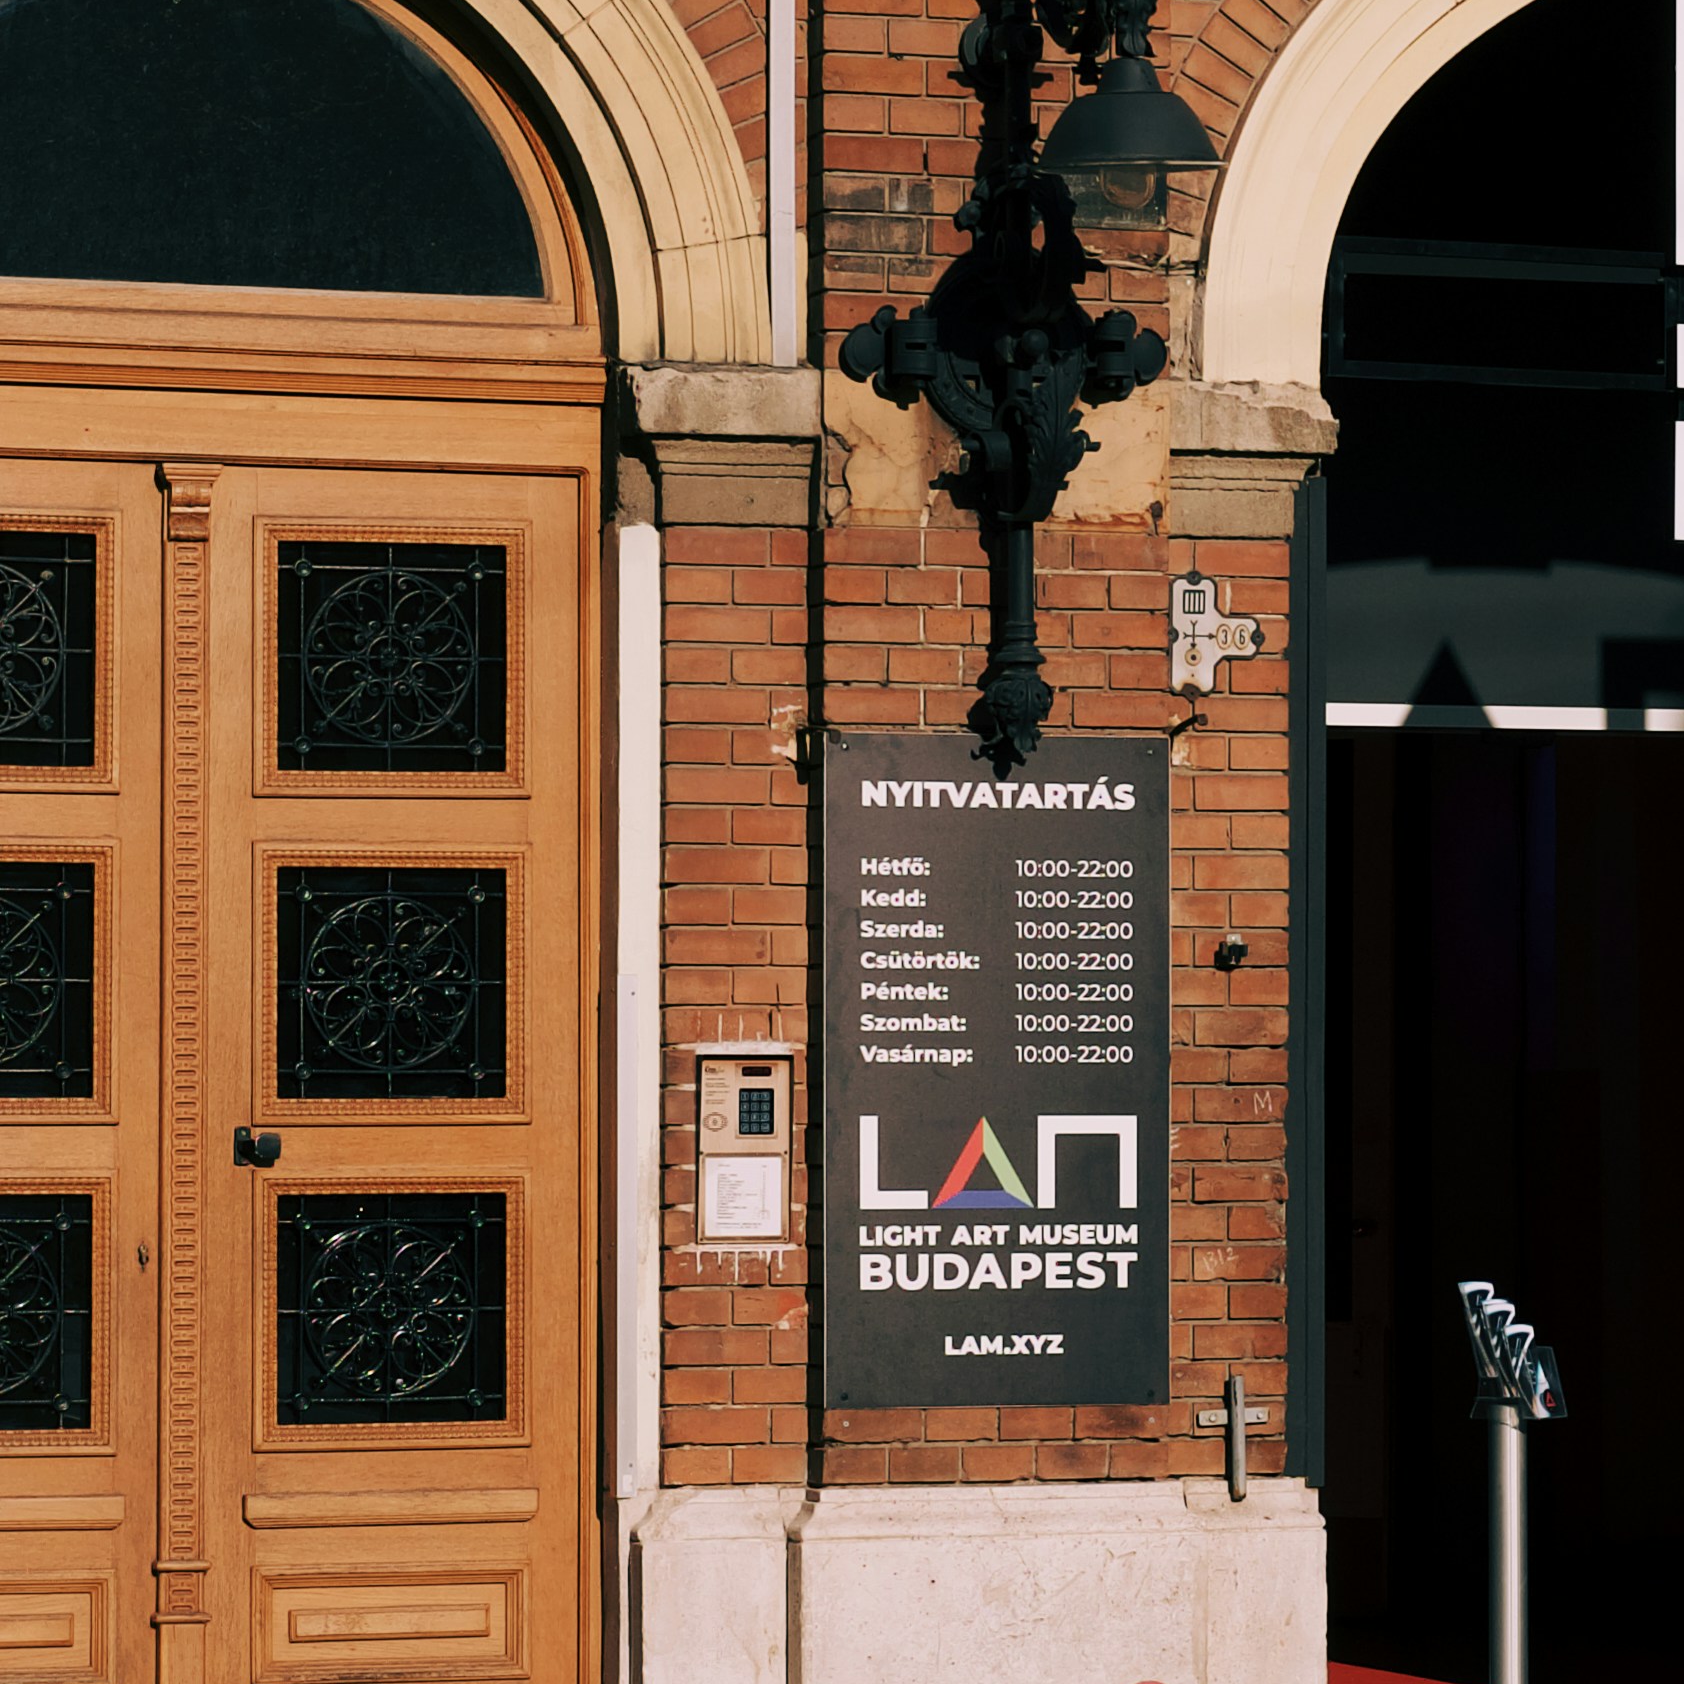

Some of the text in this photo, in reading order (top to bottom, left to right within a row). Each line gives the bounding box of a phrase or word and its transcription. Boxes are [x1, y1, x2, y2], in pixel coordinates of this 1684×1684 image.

[862, 777, 1135, 810] NYITVATARTÁS
[861, 857, 1133, 877] Hétfő: 10:00-22:00
[861, 889, 1133, 908] Kedd: 10:00-22:00
[861, 920, 1133, 939] Szerda: 10:00-22:00
[861, 951, 1133, 970] Csütörtök: 10:00-22:00
[861, 982, 1133, 1001] Péntek: 10:00-22:00
[860, 1013, 1133, 1032] Szombat: 10:00-22:00
[860, 1044, 1133, 1066] Vasárnap: 10:00-22:00
[860, 1224, 1138, 1246] LIGHT ART MUSEUM
[860, 1252, 1138, 1290] BUDAPEST
[945, 1335, 1064, 1355] LAM.XYZ
